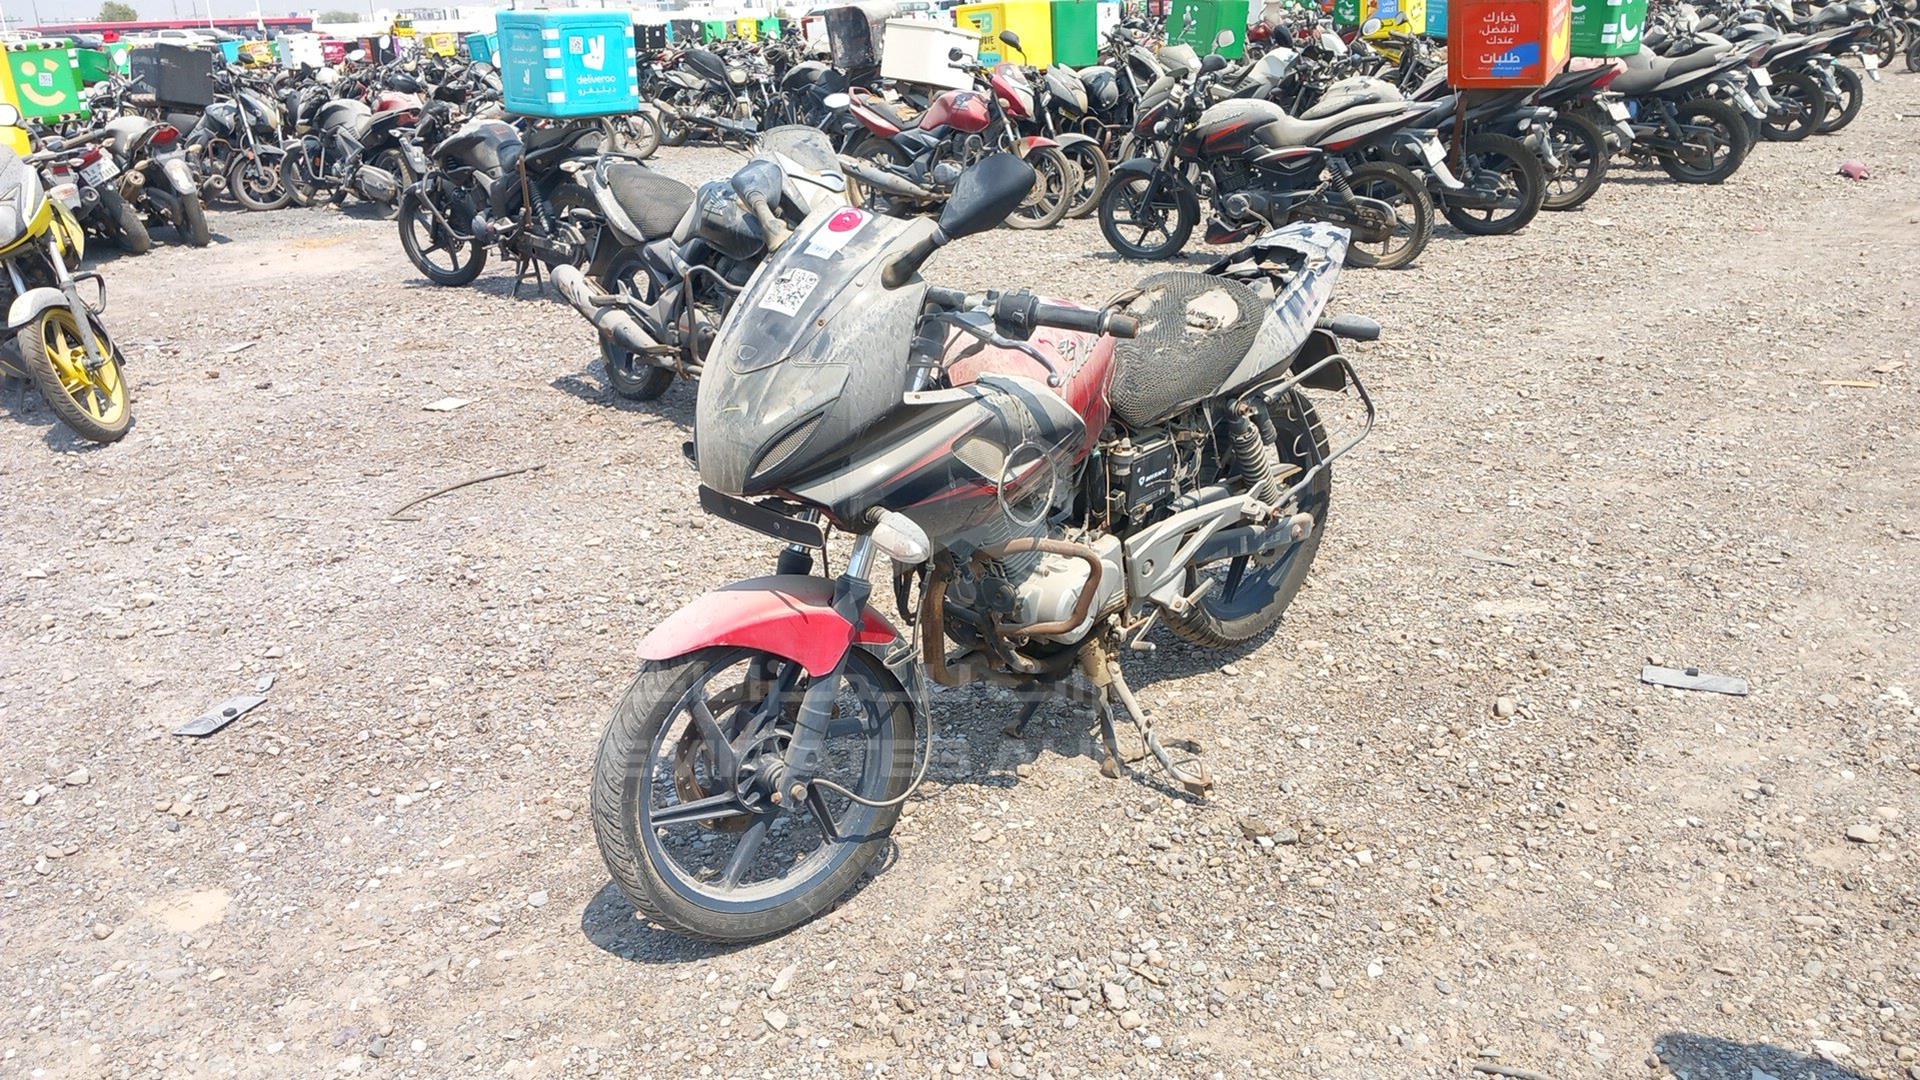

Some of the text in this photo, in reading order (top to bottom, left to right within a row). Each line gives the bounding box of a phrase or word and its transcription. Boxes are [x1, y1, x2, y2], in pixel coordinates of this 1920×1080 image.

[1483, 11, 1516, 24] خيارك
[1486, 36, 1513, 45] عندك
[1480, 53, 1520, 66] طلبات
[577, 75, 616, 84] deliveroo
